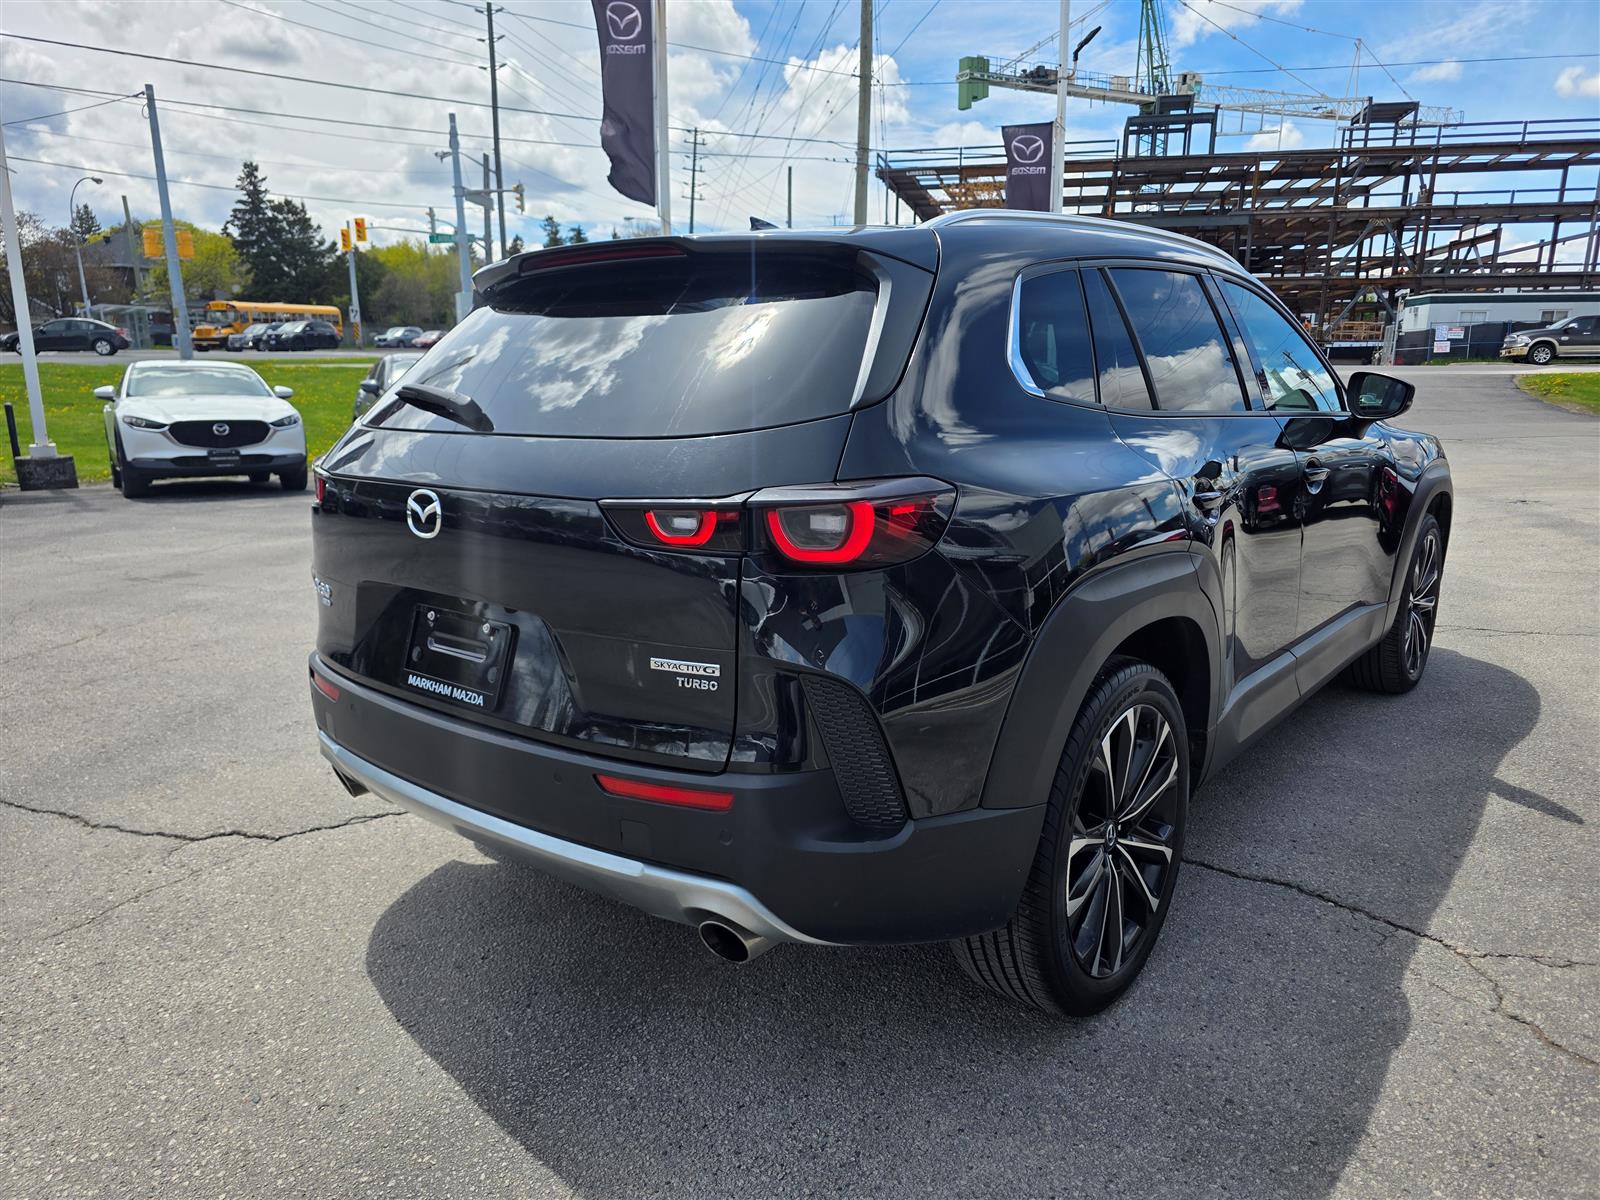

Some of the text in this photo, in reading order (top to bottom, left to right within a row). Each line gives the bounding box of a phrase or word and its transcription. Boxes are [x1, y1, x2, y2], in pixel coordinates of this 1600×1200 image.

[408, 674, 484, 707] MARKHAM MAZDA
[676, 677, 718, 691] TURBO
